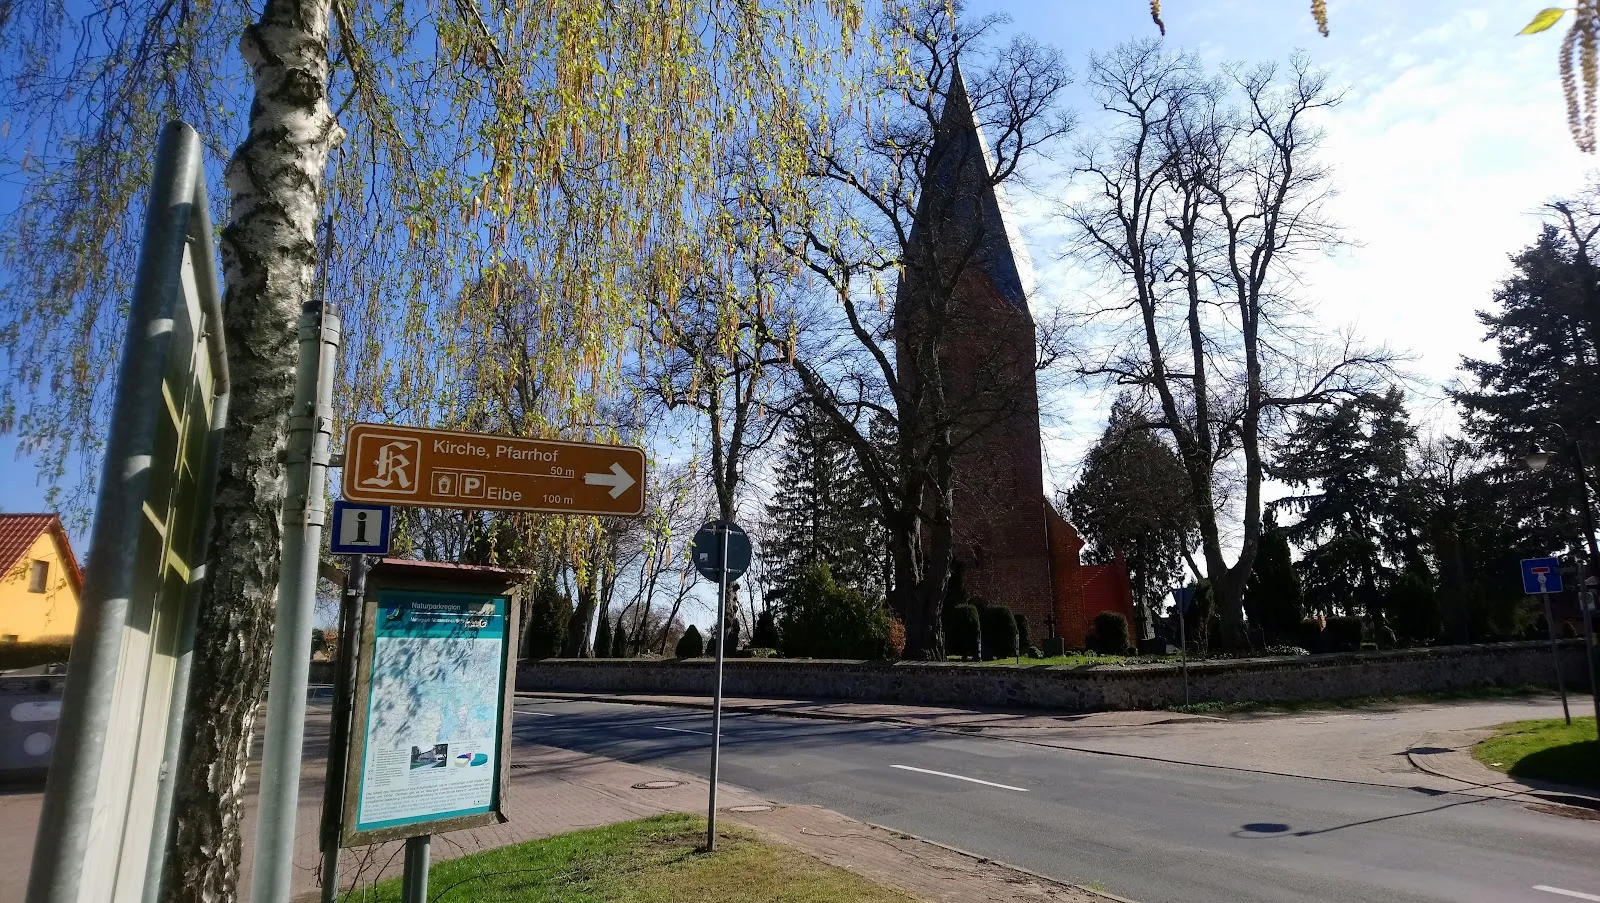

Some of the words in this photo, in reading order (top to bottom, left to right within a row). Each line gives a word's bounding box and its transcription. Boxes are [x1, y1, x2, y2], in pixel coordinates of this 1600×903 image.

[433, 439, 490, 459] Kirche,
[496, 445, 559, 462] Pfarrhof
[550, 466, 563, 476] 50
[565, 468, 575, 477] m
[464, 477, 480, 494] P
[487, 486, 522, 501] Eibe
[543, 494, 561, 504] 100
[563, 496, 573, 504] m
[411, 602, 461, 611] Naturparkregion
